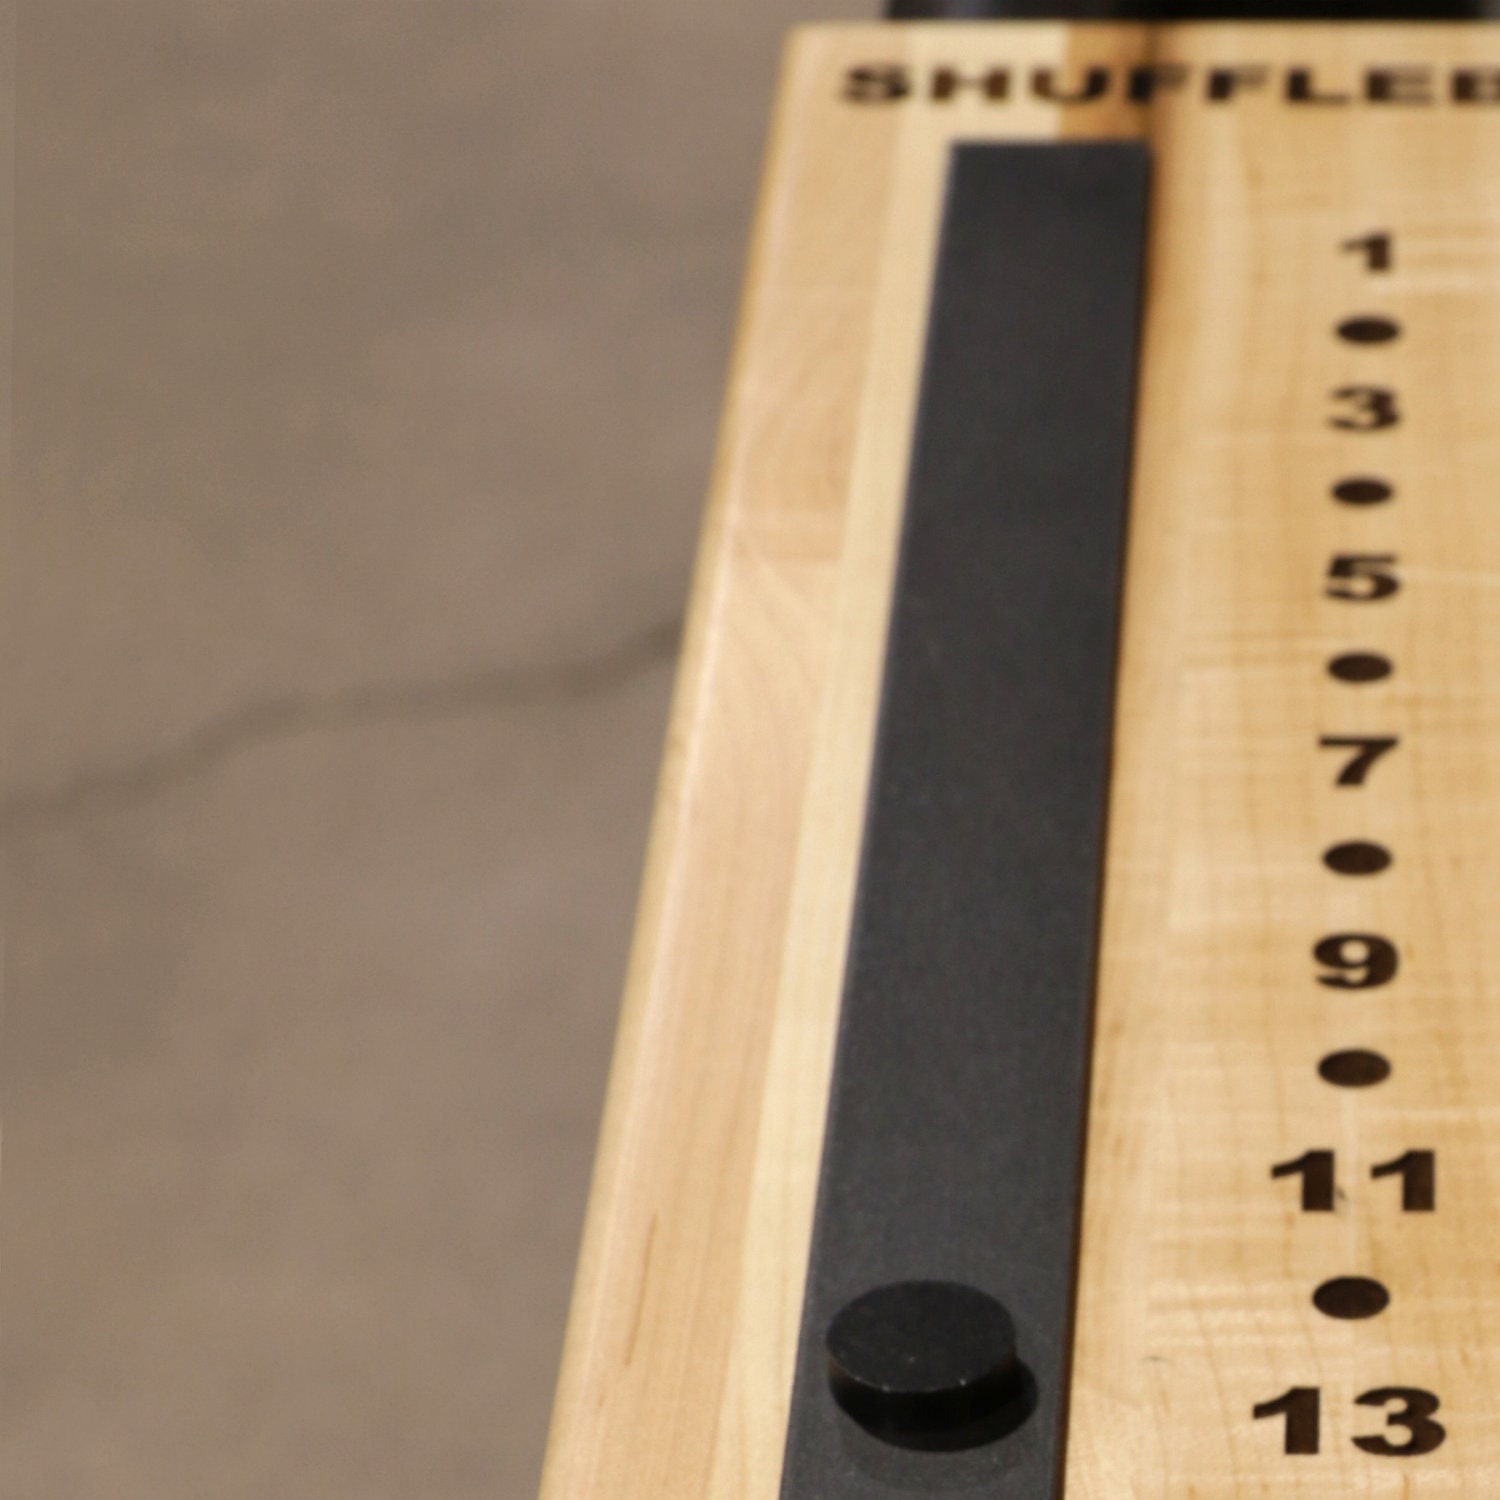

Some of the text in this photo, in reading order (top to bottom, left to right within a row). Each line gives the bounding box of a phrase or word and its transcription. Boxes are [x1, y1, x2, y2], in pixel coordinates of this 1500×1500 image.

[1338, 231, 1394, 274] 1
[1328, 386, 1402, 433] 3
[1325, 553, 1400, 602] 5
[1319, 736, 1398, 787] 7
[1313, 933, 1399, 990] 9
[1271, 1150, 1435, 1212] 11
[1253, 1386, 1446, 1457] 13
